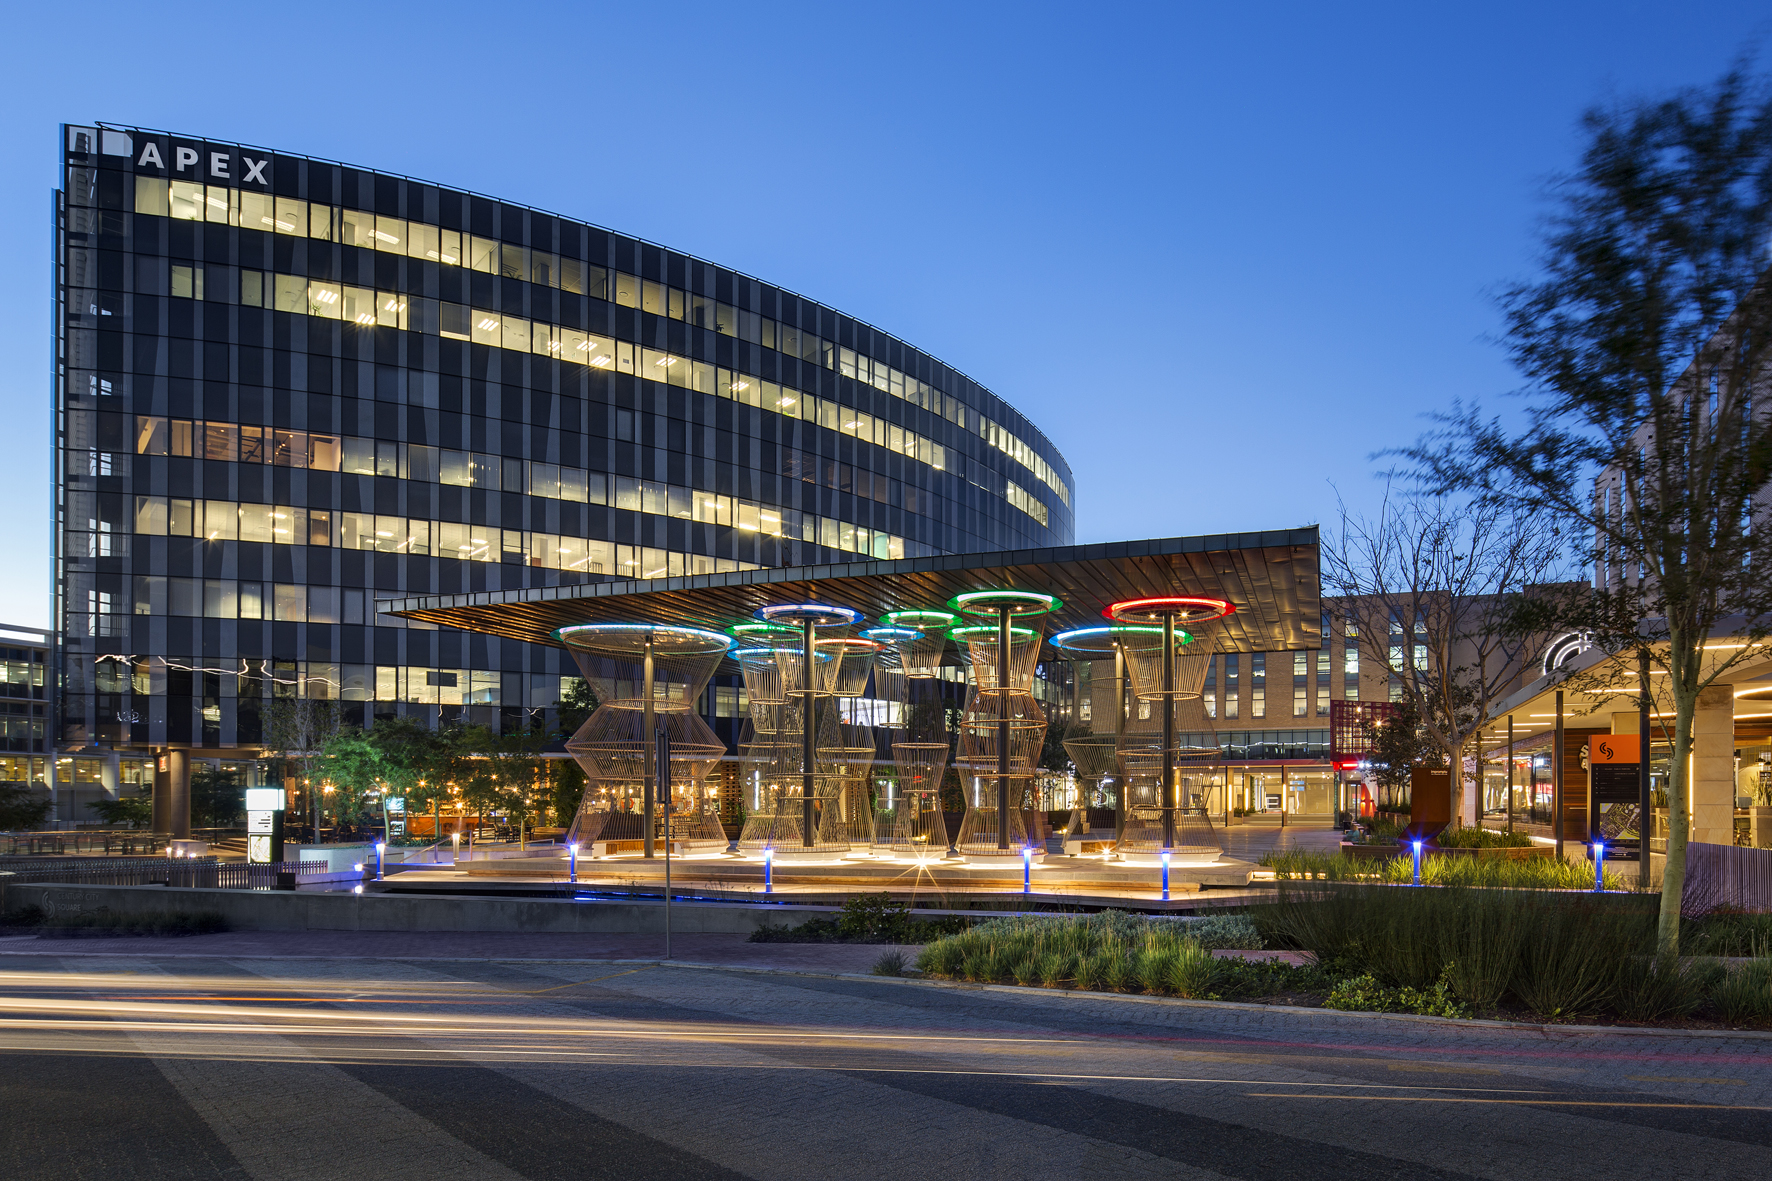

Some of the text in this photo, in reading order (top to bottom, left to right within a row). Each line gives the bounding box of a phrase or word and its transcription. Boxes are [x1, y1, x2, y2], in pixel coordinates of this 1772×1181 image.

[138, 142, 268, 185] APEX
[57, 892, 99, 901] CENTURY CITY
[57, 903, 81, 911] SQUARE
